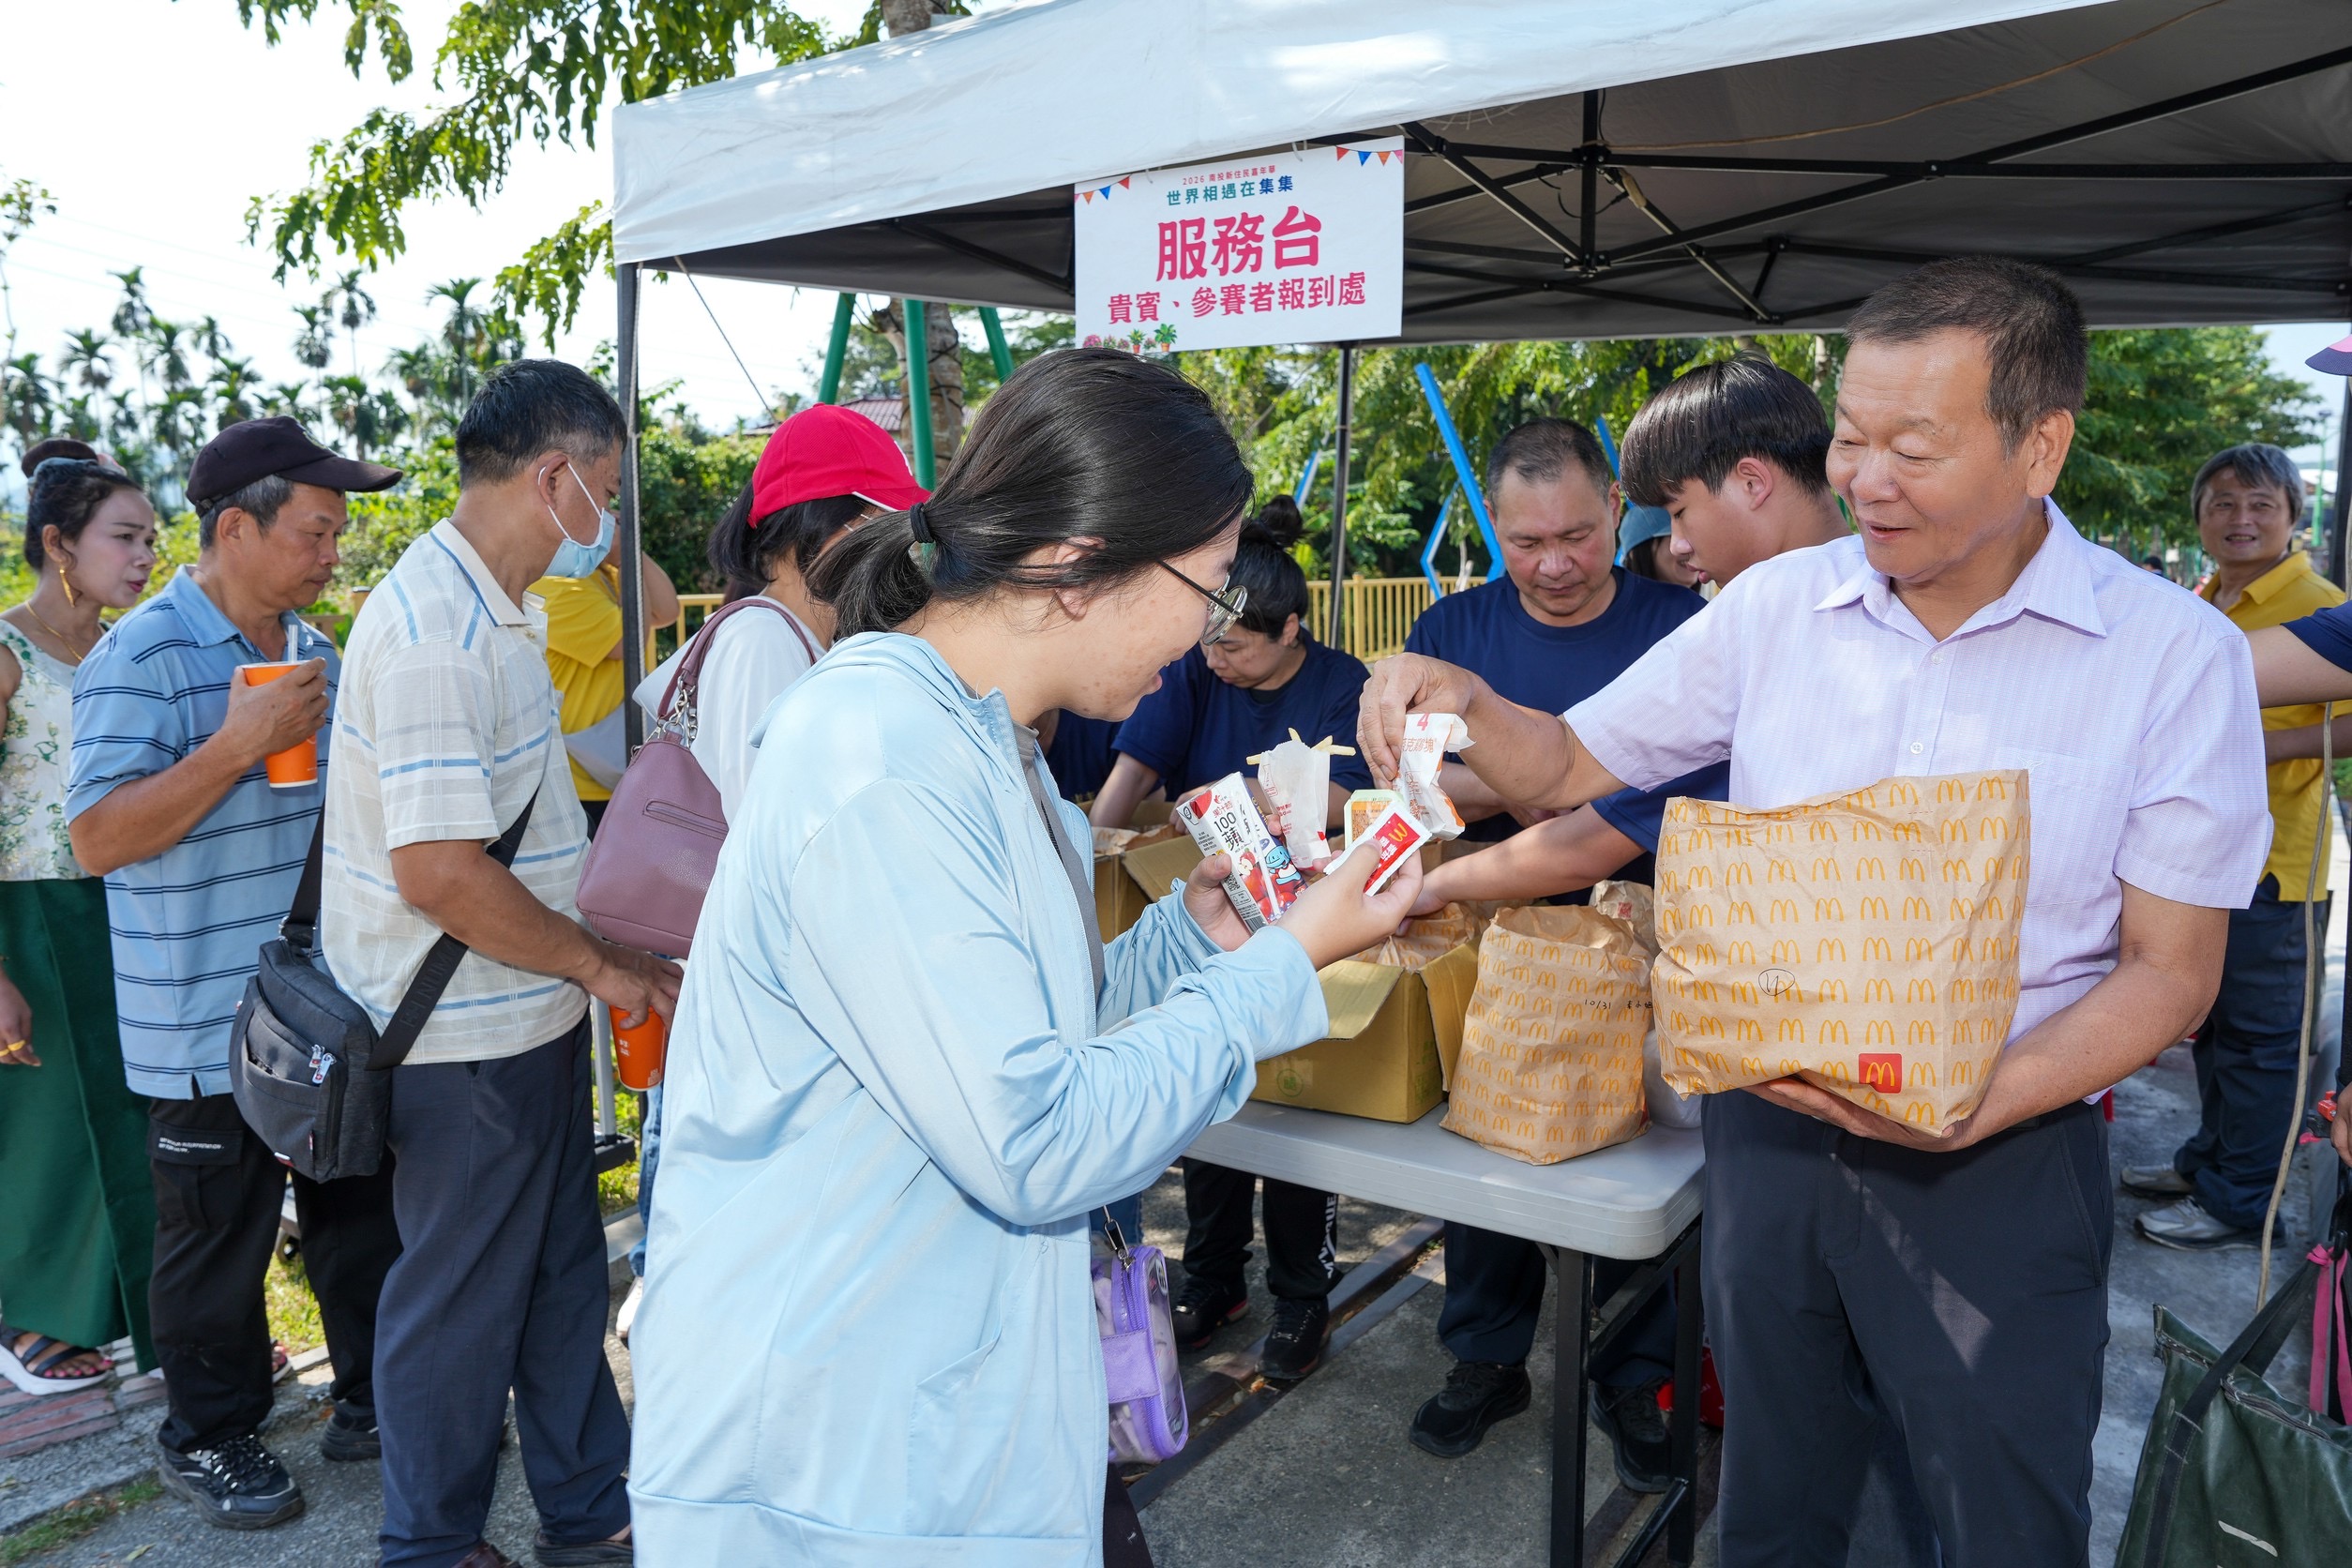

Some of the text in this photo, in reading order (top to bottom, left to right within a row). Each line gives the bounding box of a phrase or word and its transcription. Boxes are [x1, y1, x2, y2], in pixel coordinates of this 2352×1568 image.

[1167, 175, 1293, 206] 世界相遇在集集
[1155, 205, 1321, 281] 服務台
[1108, 272, 1366, 324] 貴賓、參賽者報到處
[1417, 713, 1430, 731] 4
[1585, 1000, 1610, 1009] 10/31
